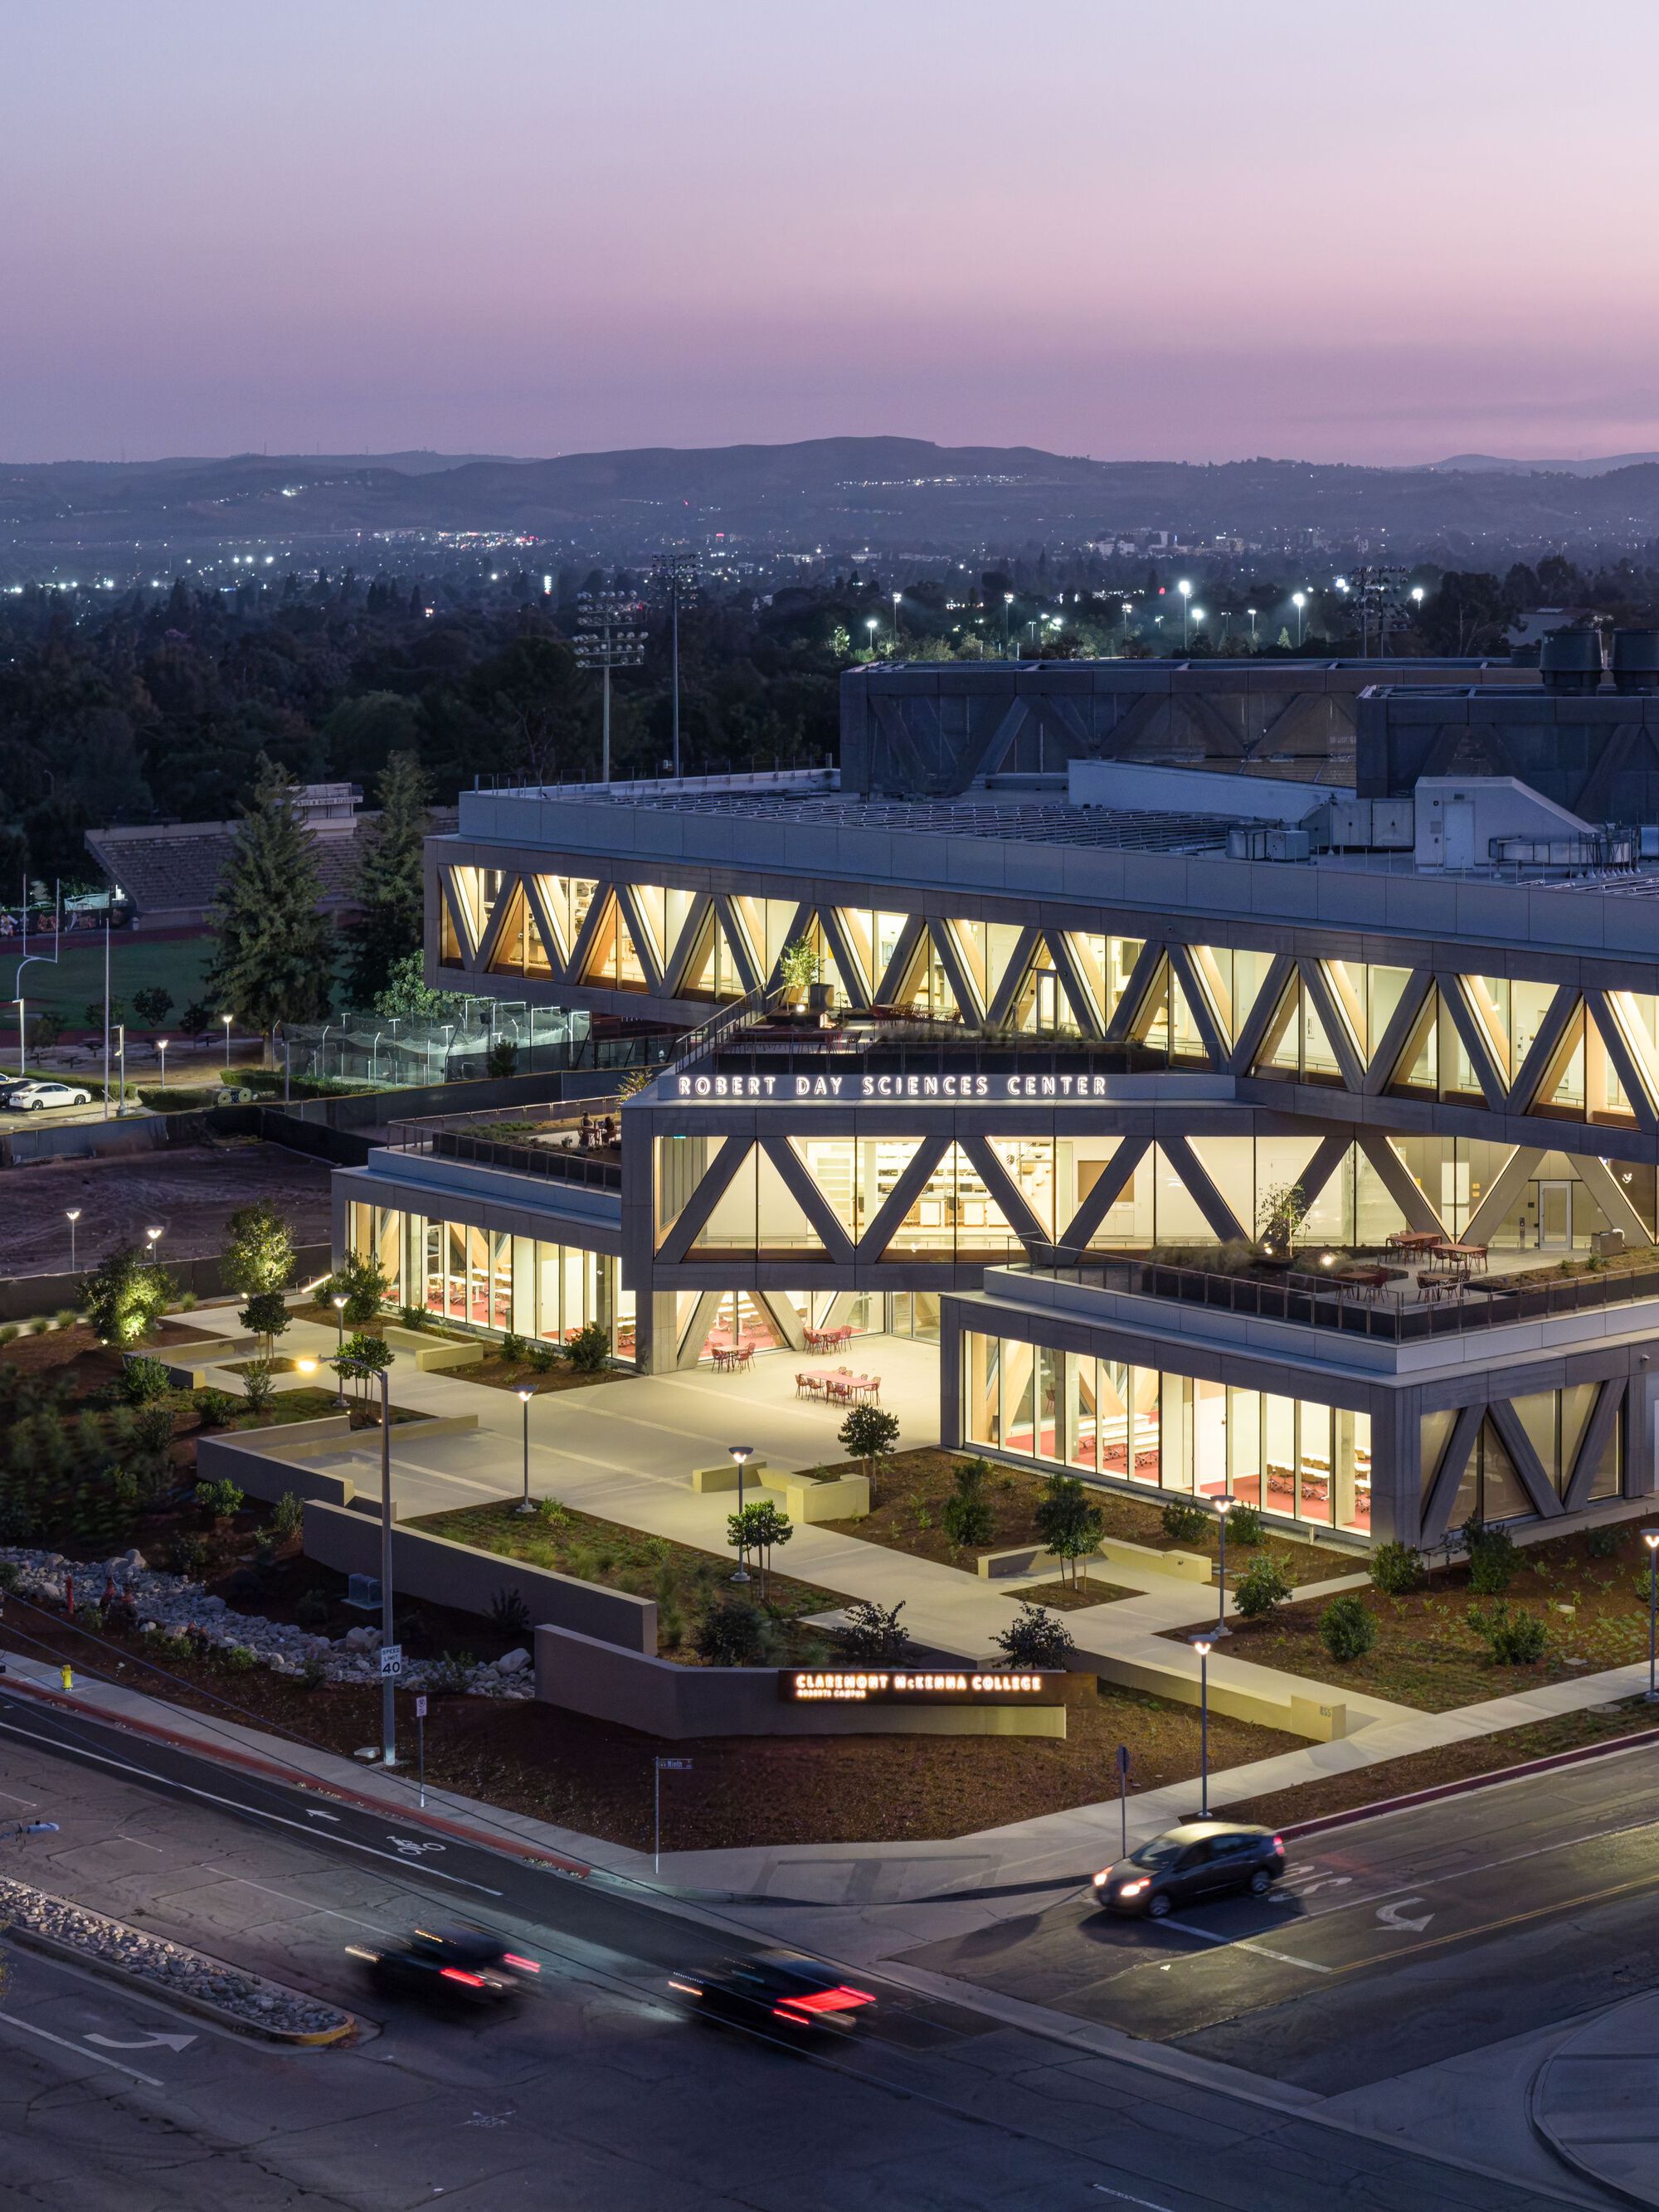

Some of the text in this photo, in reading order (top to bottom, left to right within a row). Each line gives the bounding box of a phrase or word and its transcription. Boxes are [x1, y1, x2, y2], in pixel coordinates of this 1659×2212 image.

[679, 1076, 1106, 1095] ROBERT DAY SCIENCES CENTER
[382, 1661, 400, 1674] 40
[795, 1674, 1042, 1691] CLAREMONT McKENNA COLLEGE
